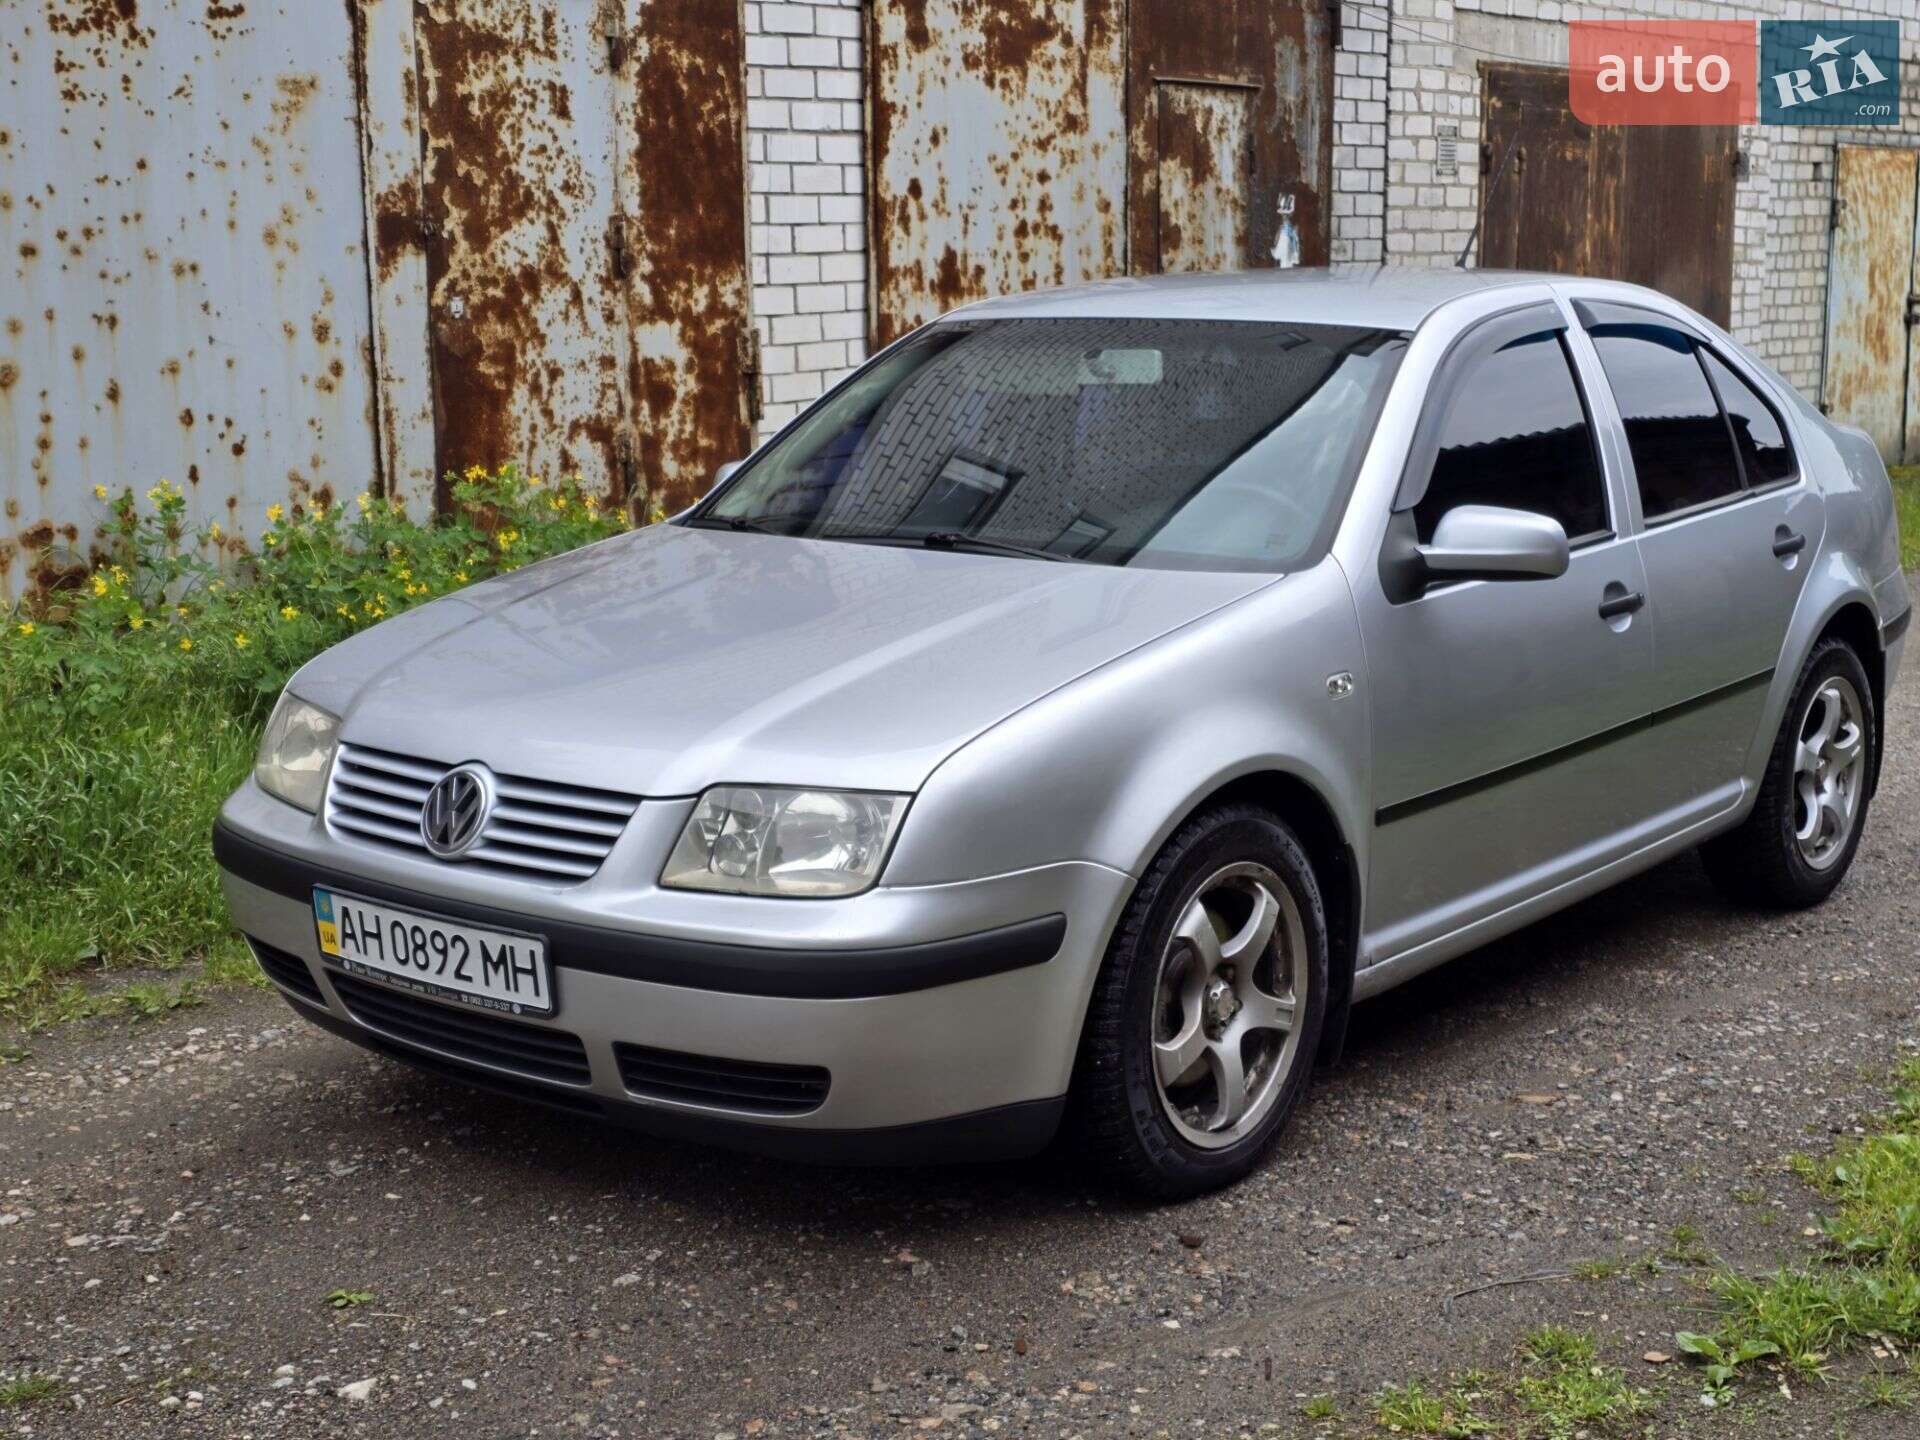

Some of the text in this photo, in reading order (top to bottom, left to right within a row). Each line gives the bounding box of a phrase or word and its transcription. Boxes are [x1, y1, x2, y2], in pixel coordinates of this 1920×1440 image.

[322, 931, 337, 946] UA
[341, 905, 385, 961] AH
[390, 919, 474, 984] 0892
[479, 939, 541, 998] MH
